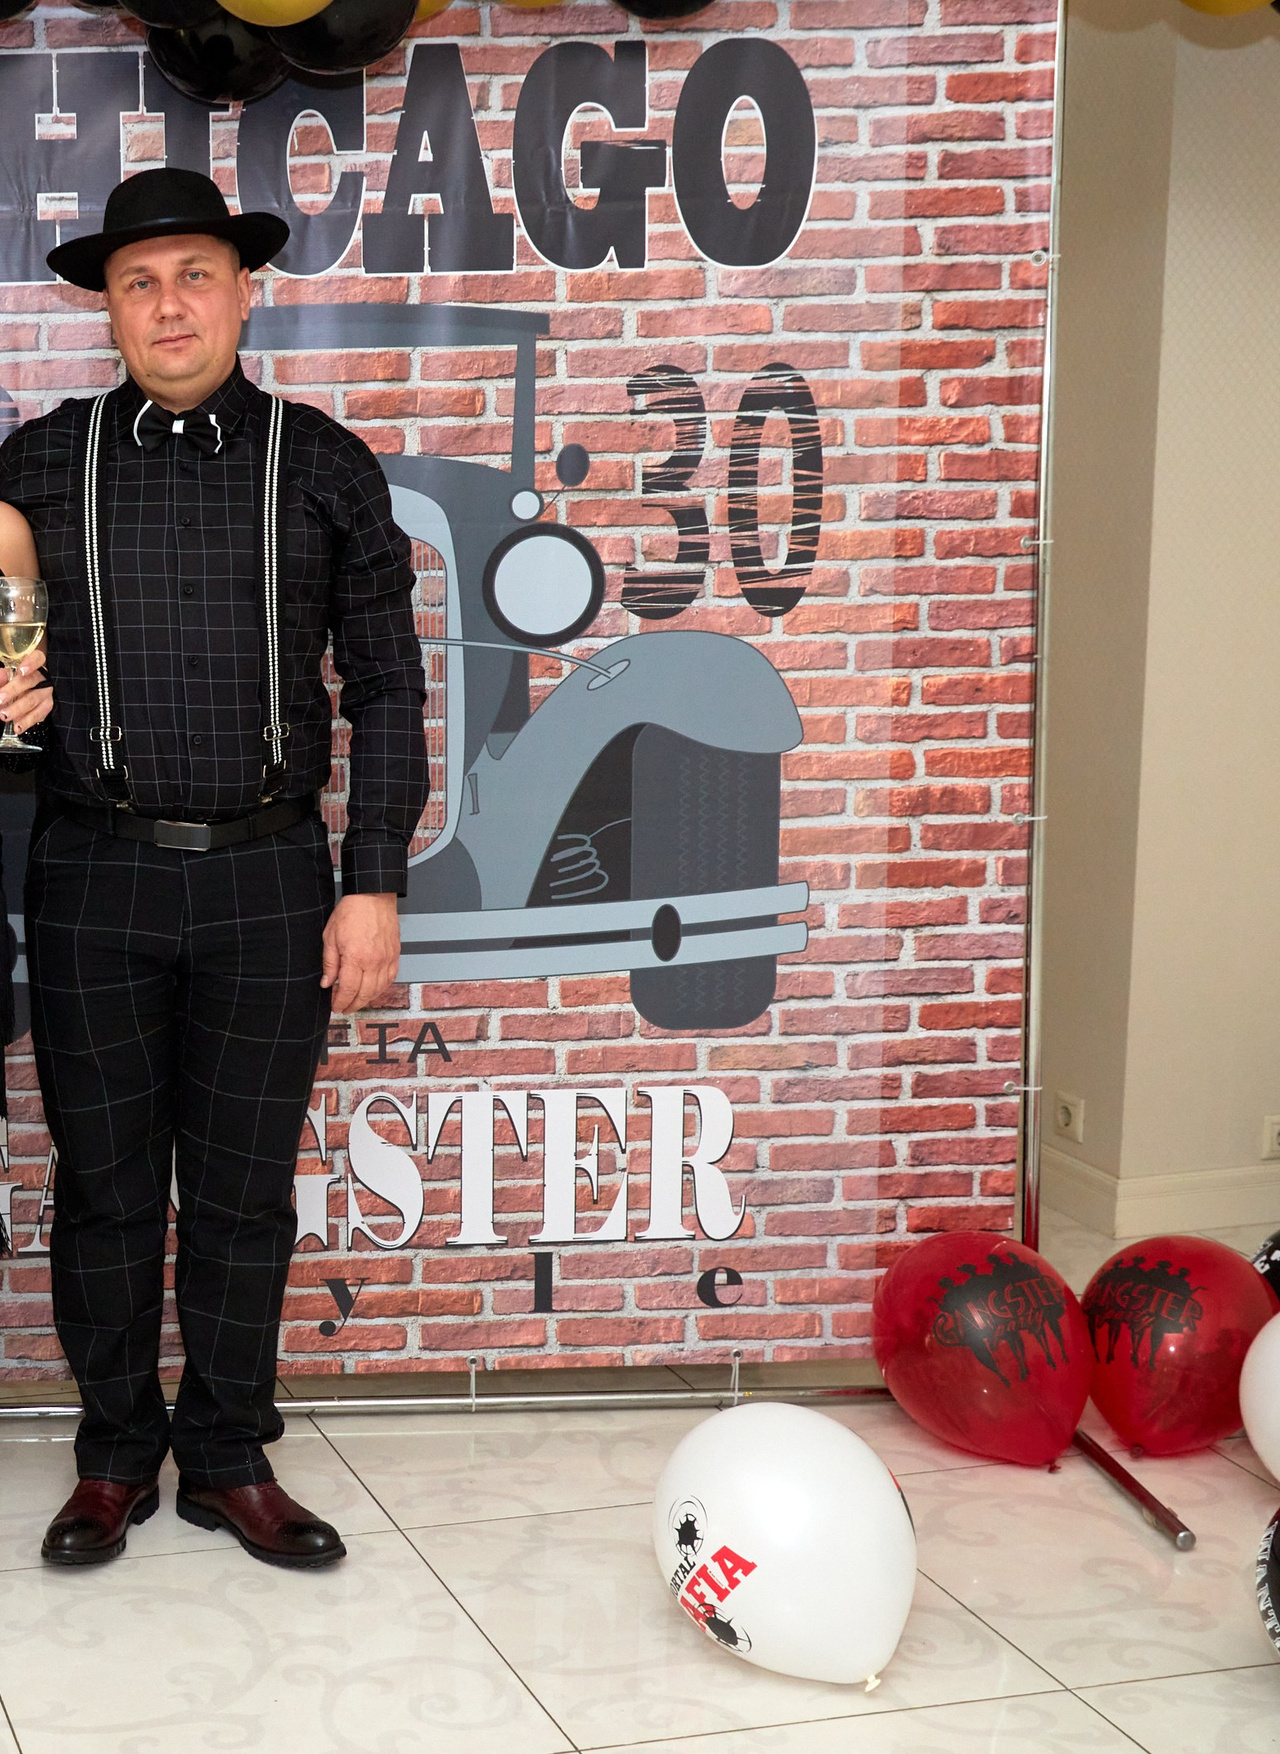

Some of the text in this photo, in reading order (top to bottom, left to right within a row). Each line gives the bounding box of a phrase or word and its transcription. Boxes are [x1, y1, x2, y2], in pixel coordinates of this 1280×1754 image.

[620, 362, 822, 620] 30
[319, 1021, 452, 1065] FIA
[1084, 1281, 1203, 1331] ANGSTER
[669, 1556, 696, 1597] ORTAL
[680, 1545, 758, 1632] AFIA
